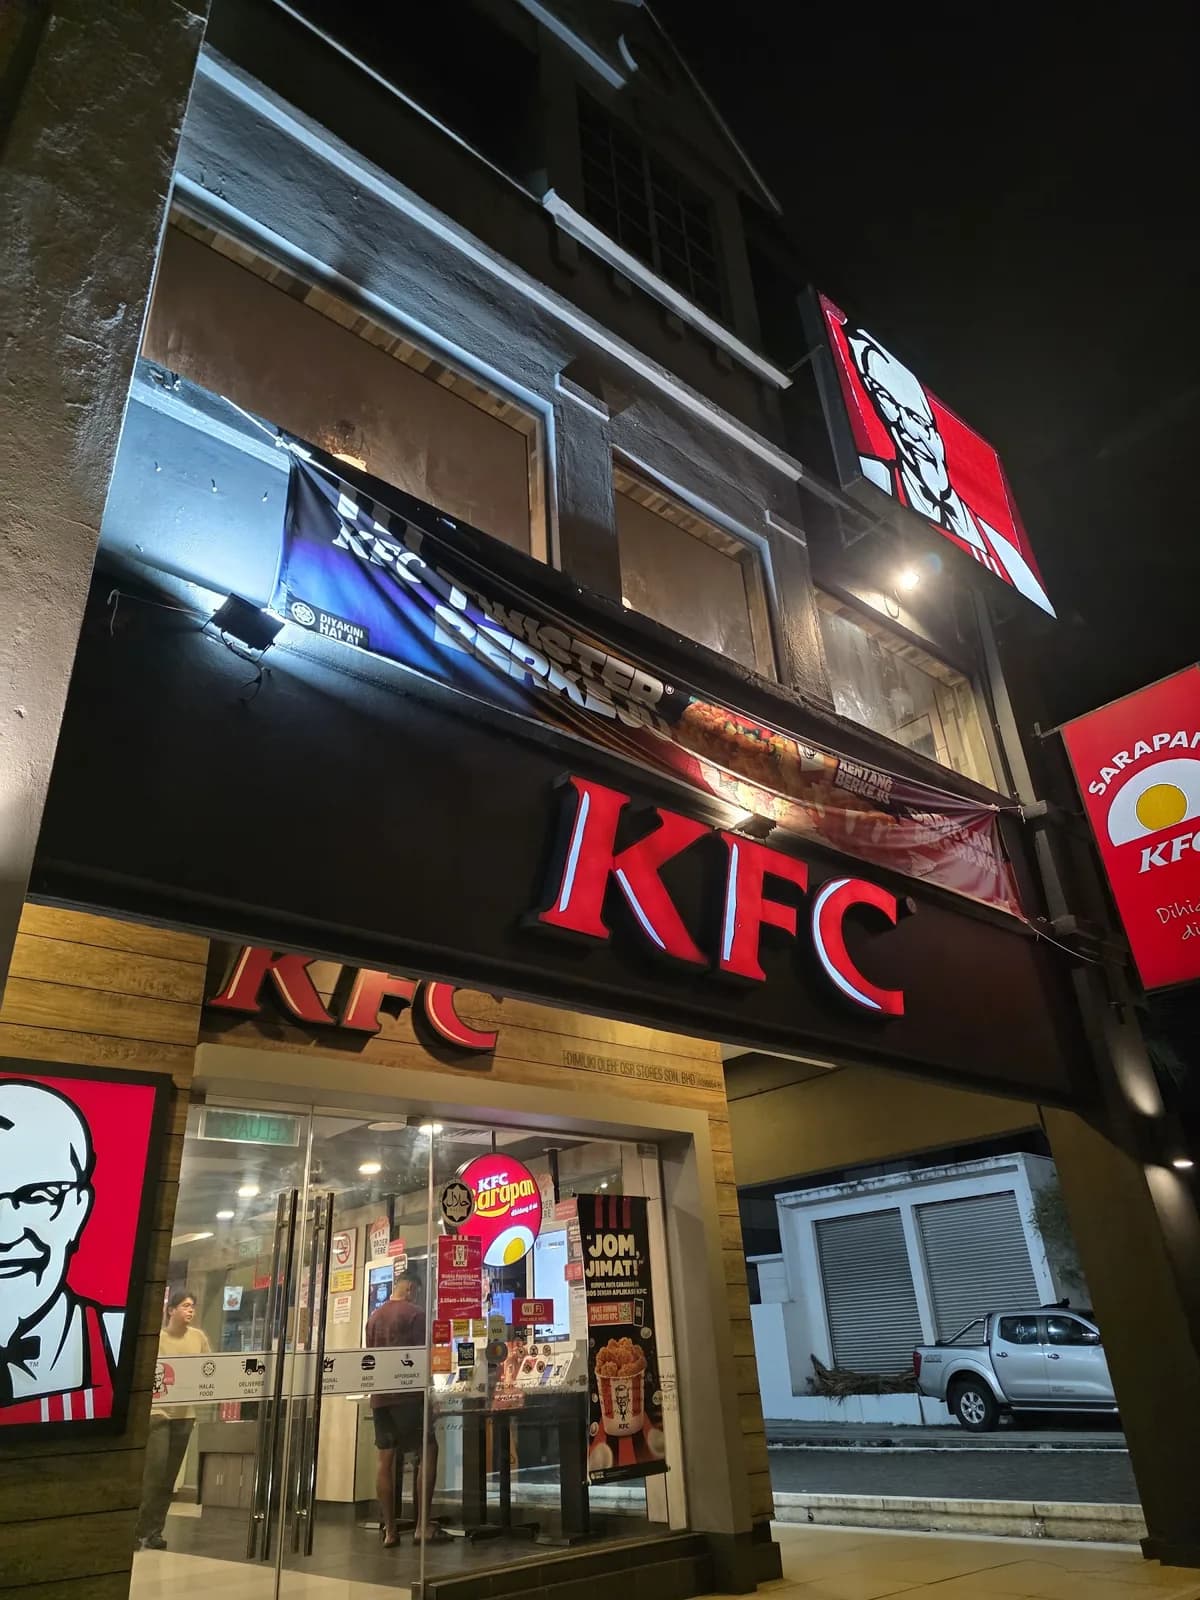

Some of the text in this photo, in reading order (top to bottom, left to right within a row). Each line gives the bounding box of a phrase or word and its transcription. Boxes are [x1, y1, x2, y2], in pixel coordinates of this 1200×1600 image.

[331, 516, 427, 584] KFC
[319, 613, 363, 638] DIYAKINI
[319, 622, 359, 645] HALAL
[838, 759, 894, 793] KENTANG
[538, 775, 905, 1016] KFC
[211, 945, 500, 1051] KFC
[636, 1063, 664, 1080] STORES
[478, 1173, 508, 1193] KFC
